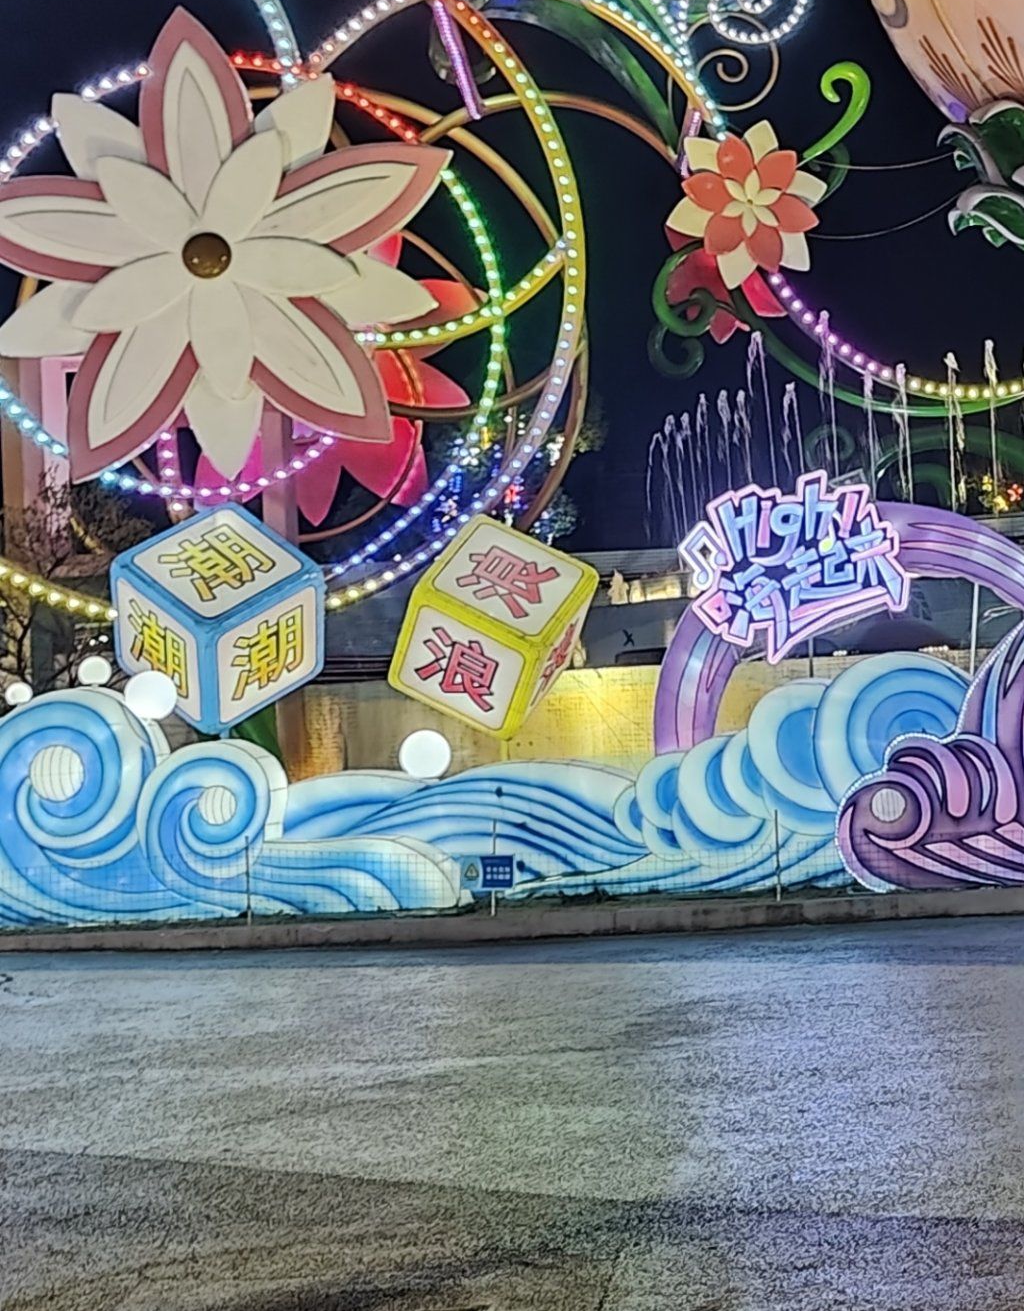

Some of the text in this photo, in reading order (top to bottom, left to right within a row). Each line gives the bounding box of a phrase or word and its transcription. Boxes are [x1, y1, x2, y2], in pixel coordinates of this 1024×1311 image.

[157, 523, 276, 603] 潮
[456, 544, 561, 619] 浪
[127, 598, 189, 700] 潮
[230, 604, 304, 702] 潮
[413, 625, 495, 713] 浪
